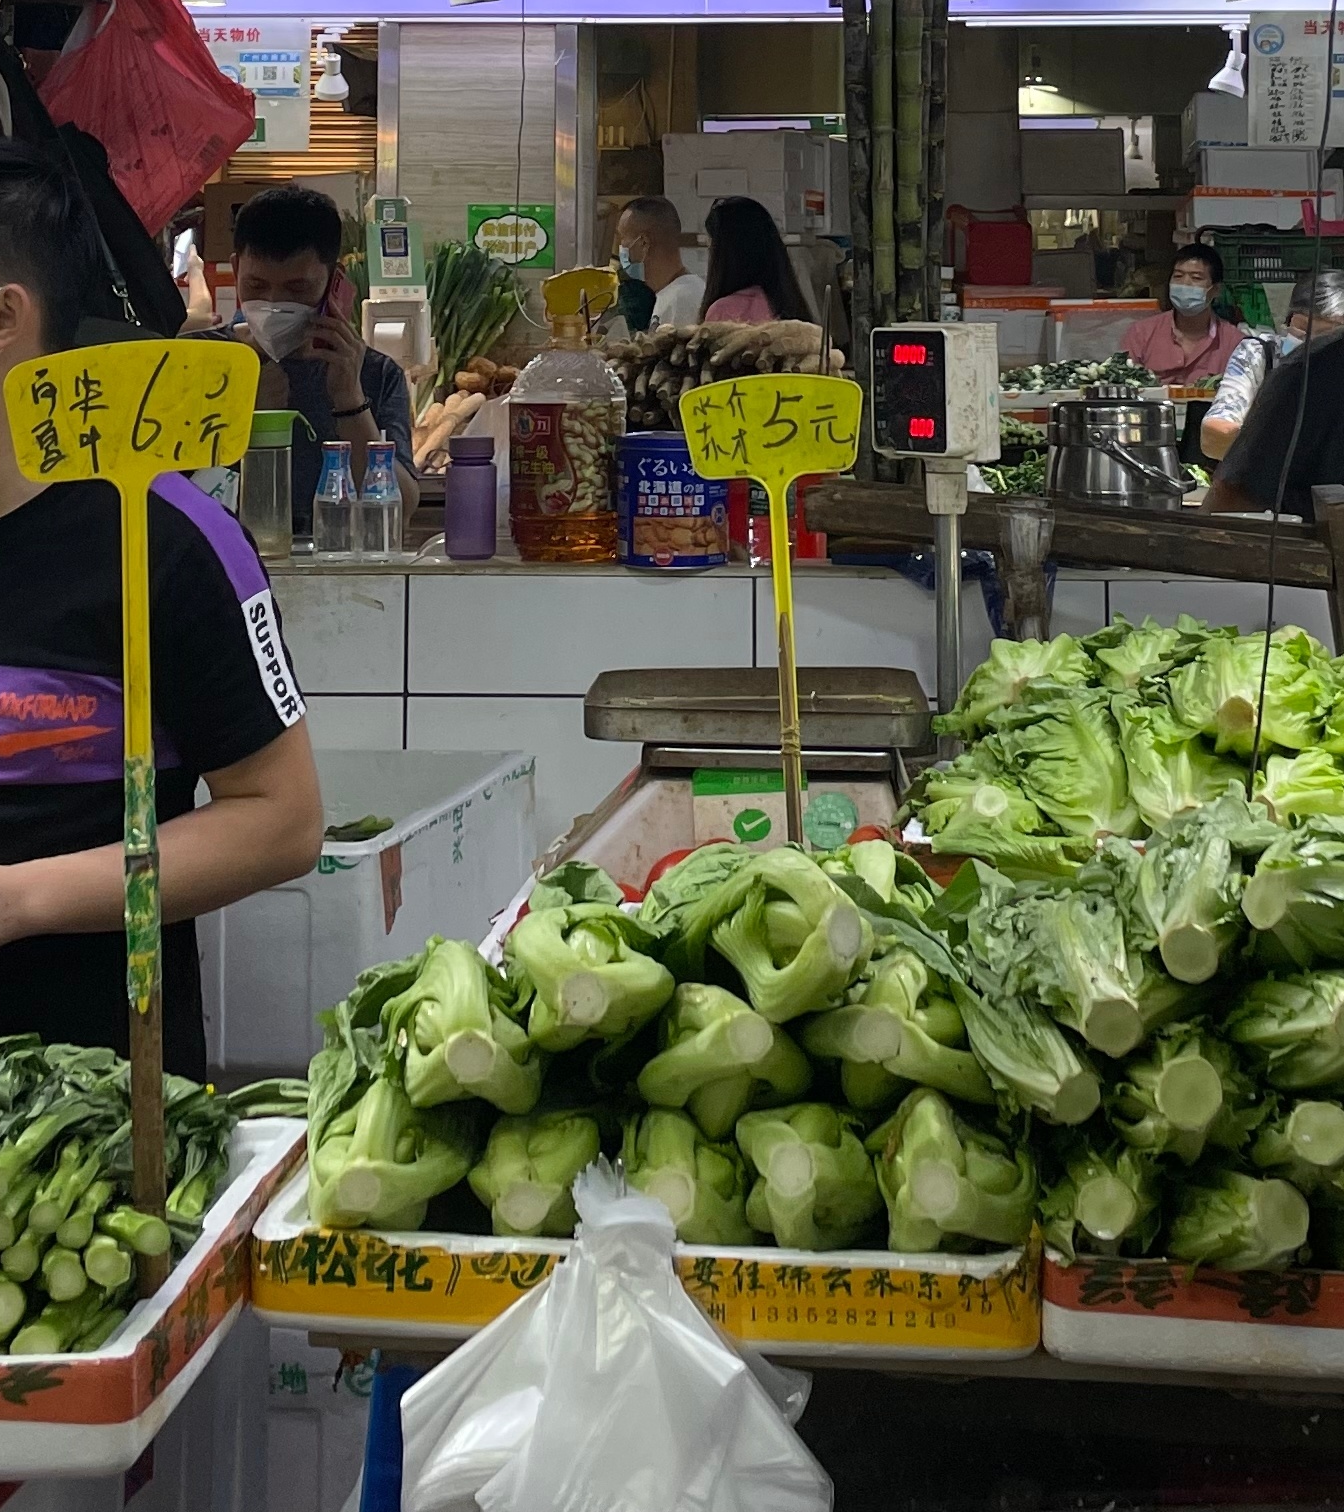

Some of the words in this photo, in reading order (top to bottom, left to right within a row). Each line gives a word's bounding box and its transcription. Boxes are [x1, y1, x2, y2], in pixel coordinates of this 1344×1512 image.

[199, 28, 261, 42] 当天物价
[763, 390, 855, 449] 5元
